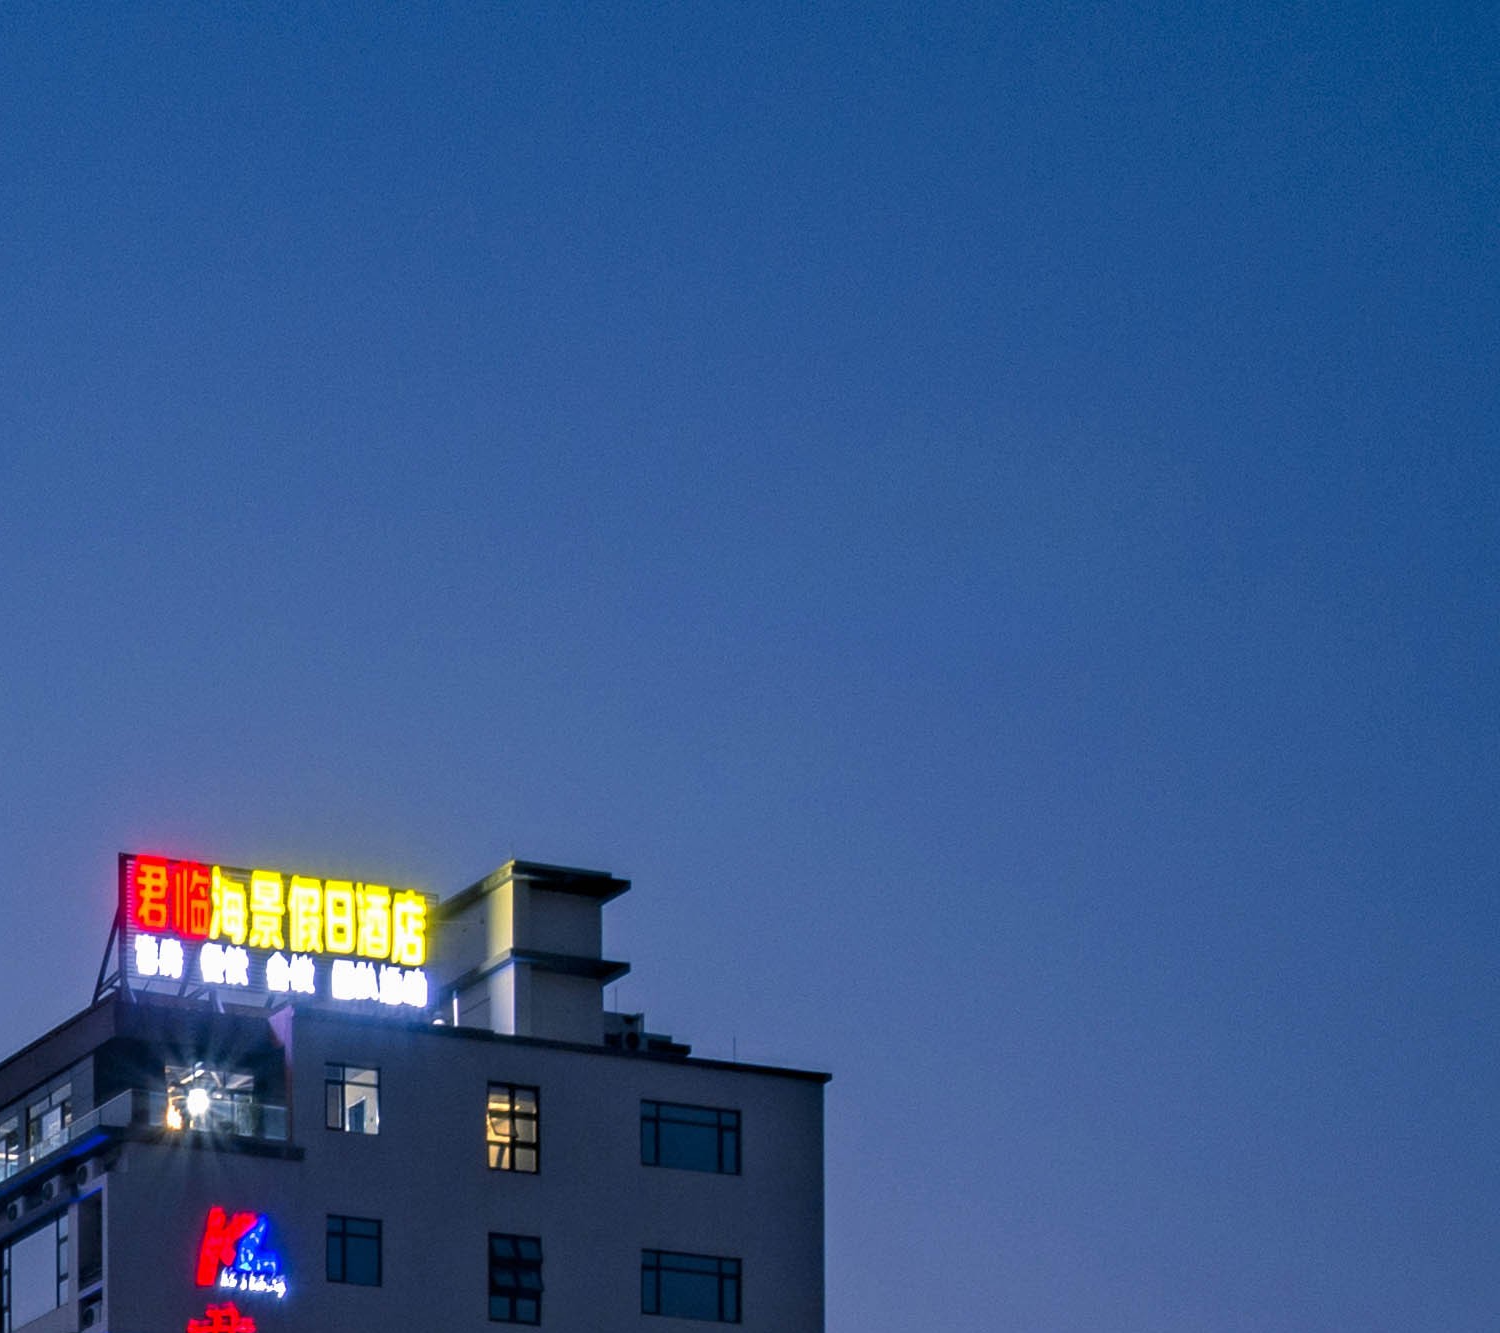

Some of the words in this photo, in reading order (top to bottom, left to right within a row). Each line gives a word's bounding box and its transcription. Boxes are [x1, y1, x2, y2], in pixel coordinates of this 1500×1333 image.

[135, 856, 427, 966] 君临海景假日酒店
